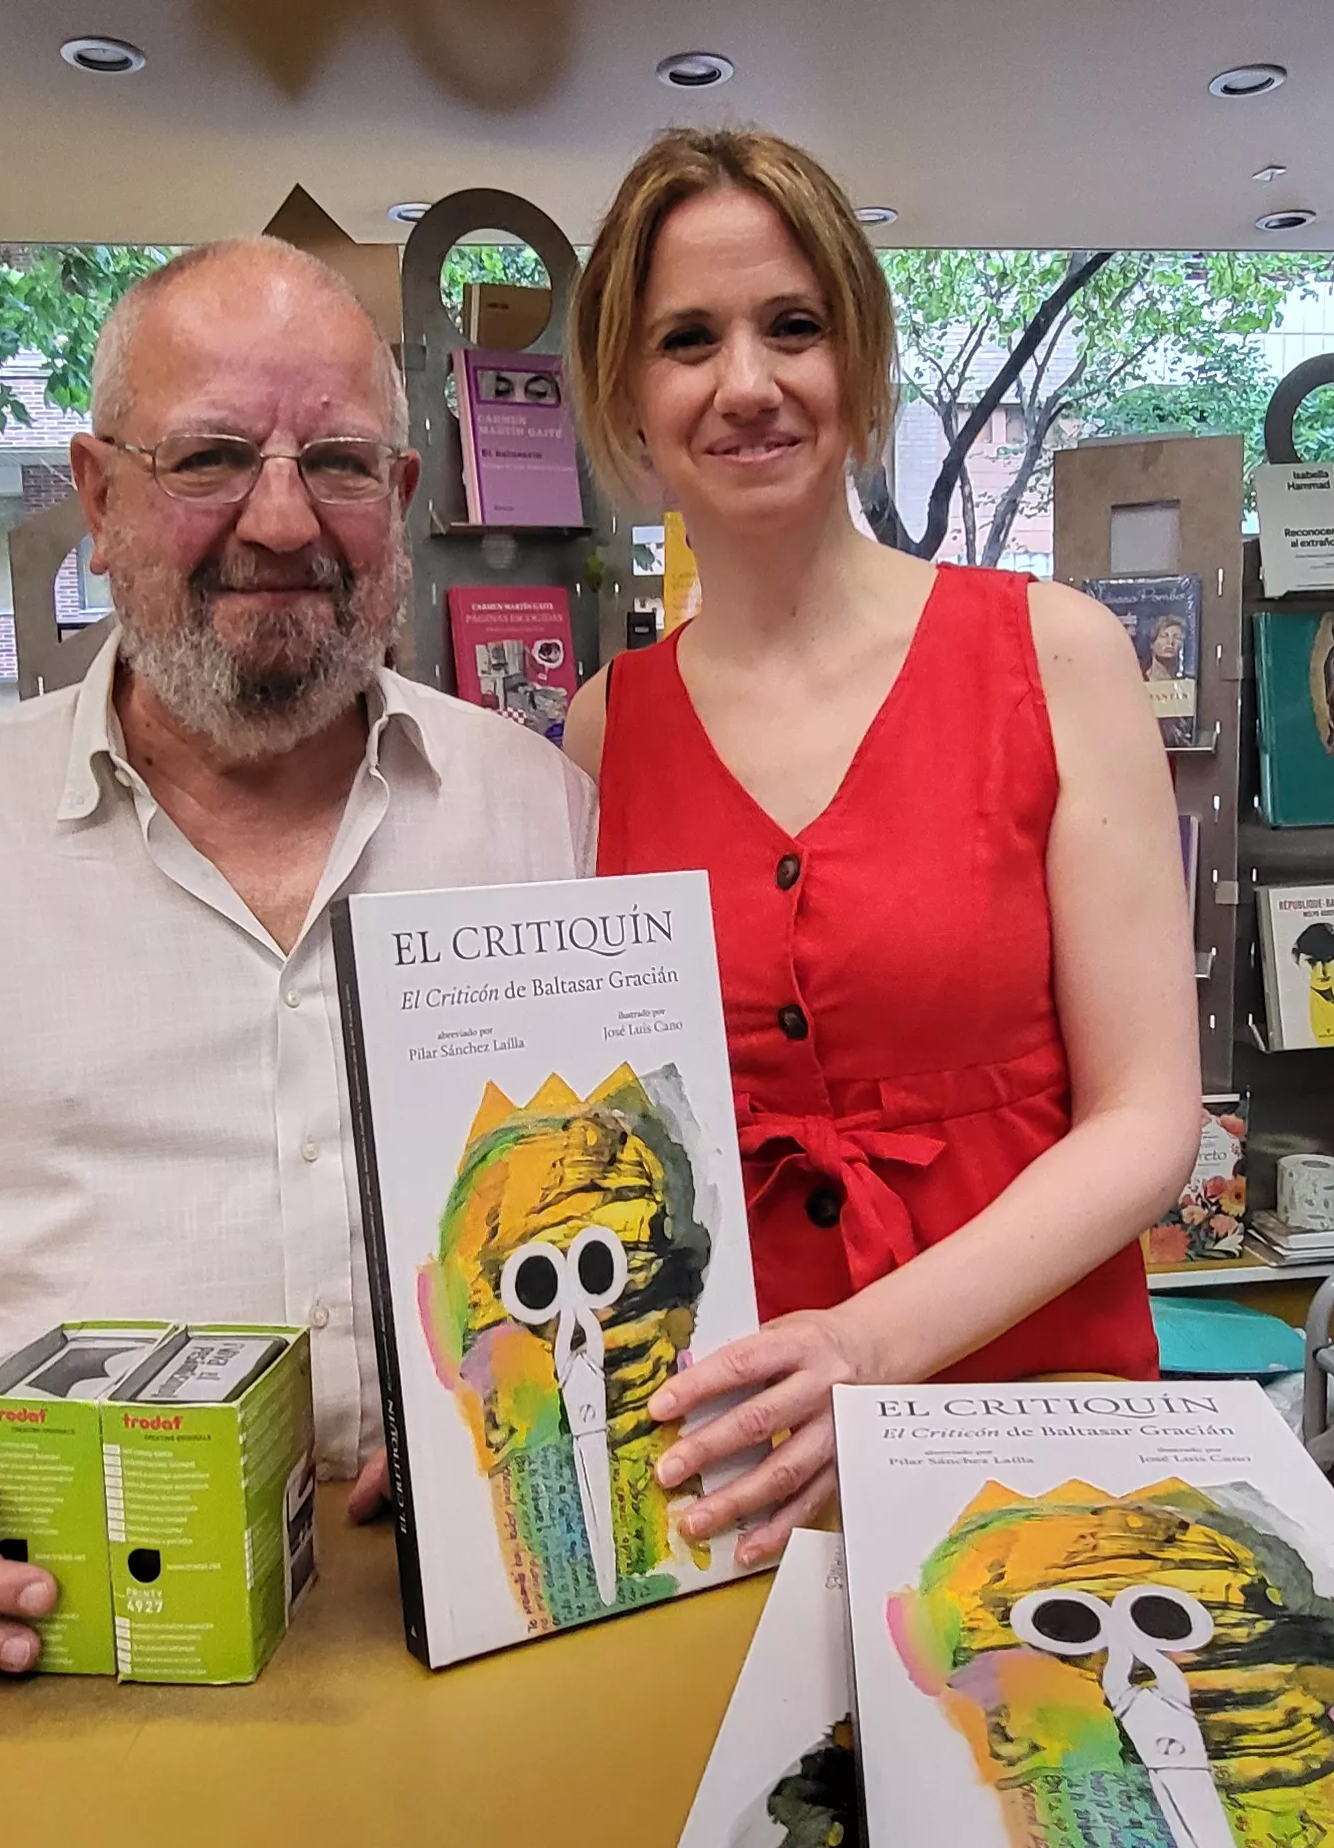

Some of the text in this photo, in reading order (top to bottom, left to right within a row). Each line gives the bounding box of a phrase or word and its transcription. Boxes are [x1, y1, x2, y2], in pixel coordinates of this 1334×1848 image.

[1292, 470, 1329, 480] Isabella
[1287, 481, 1331, 491] Hammad
[1290, 538, 1299, 548] al
[392, 904, 673, 966] EL CRITIQUÍN
[401, 966, 679, 1010] El Criticón de Baltasar Gracián
[652, 1008, 666, 1018] por
[437, 1027, 494, 1041] abreviado por
[603, 1020, 683, 1041] José Luis Cano
[409, 1047, 438, 1061] Pilar
[441, 1040, 489, 1058] Sánchez
[876, 1393, 1221, 1419] EL CRITIQUÍN
[123, 1412, 183, 1431] trodat
[882, 1424, 1236, 1440] El Criticón de Baltasar Gracián
[888, 1456, 923, 1466] Pilar
[928, 1454, 988, 1466] Sánchez
[1137, 1454, 1252, 1465] José Luis Cano
[127, 1599, 163, 1614] 4927
